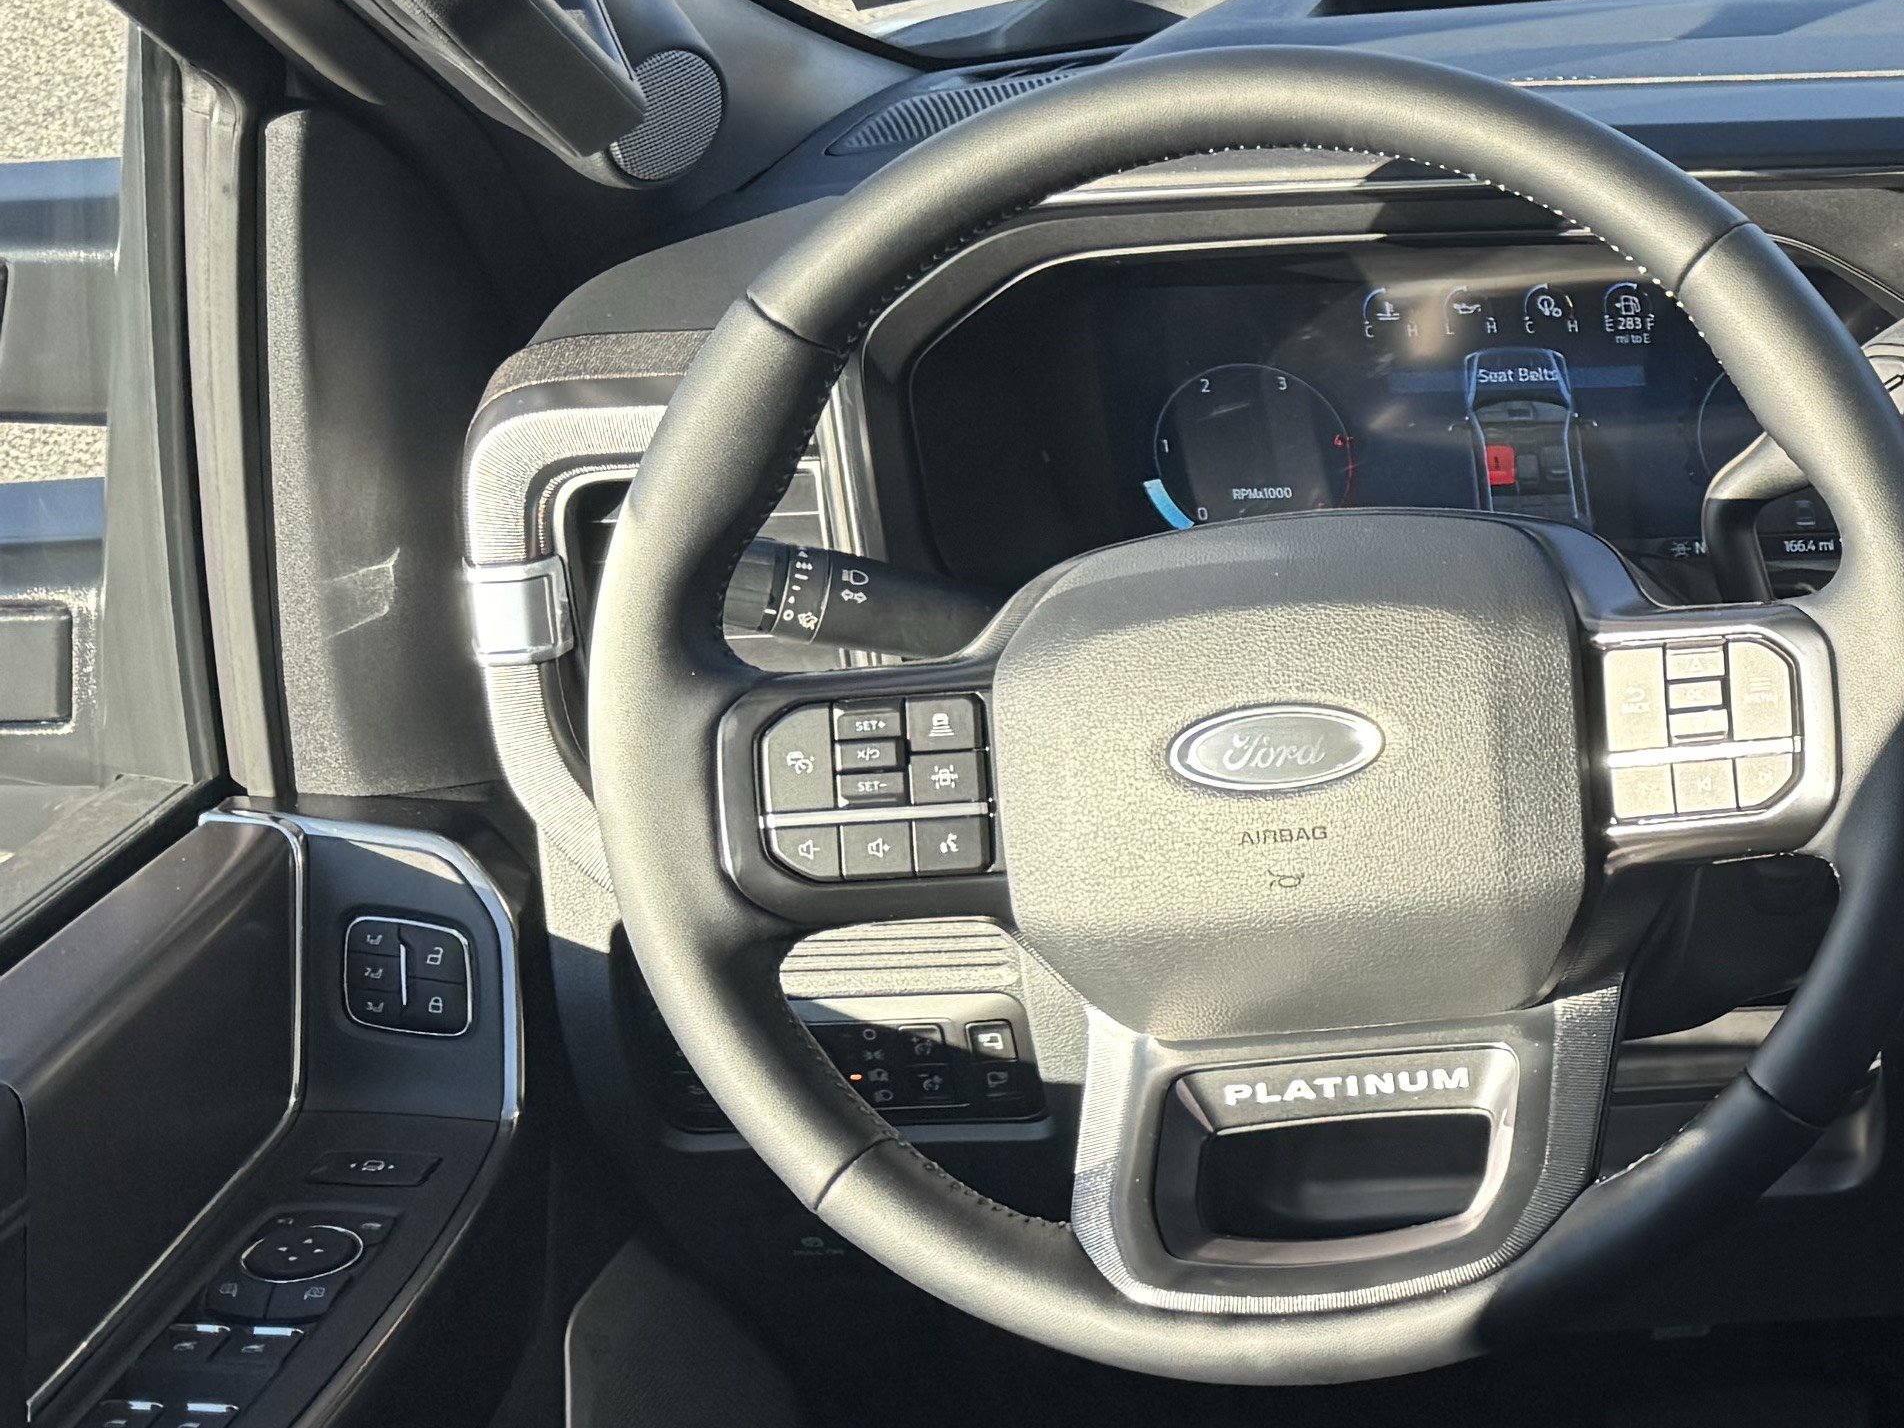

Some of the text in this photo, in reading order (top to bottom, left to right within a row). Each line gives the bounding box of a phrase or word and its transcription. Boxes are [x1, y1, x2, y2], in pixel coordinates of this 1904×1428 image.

[1568, 320, 1579, 332] H
[1617, 317, 1642, 330] 283
[1478, 368, 1558, 383] Seat Belts
[1200, 378, 1211, 393] 2
[1278, 376, 1287, 391] 3
[1162, 439, 1169, 453] 1
[1198, 507, 1208, 521] 0
[1818, 540, 1835, 551] mi
[1222, 732, 1325, 771] Ford
[1238, 825, 1329, 847] AIRBAG
[1224, 1067, 1470, 1107] PLATINUM
